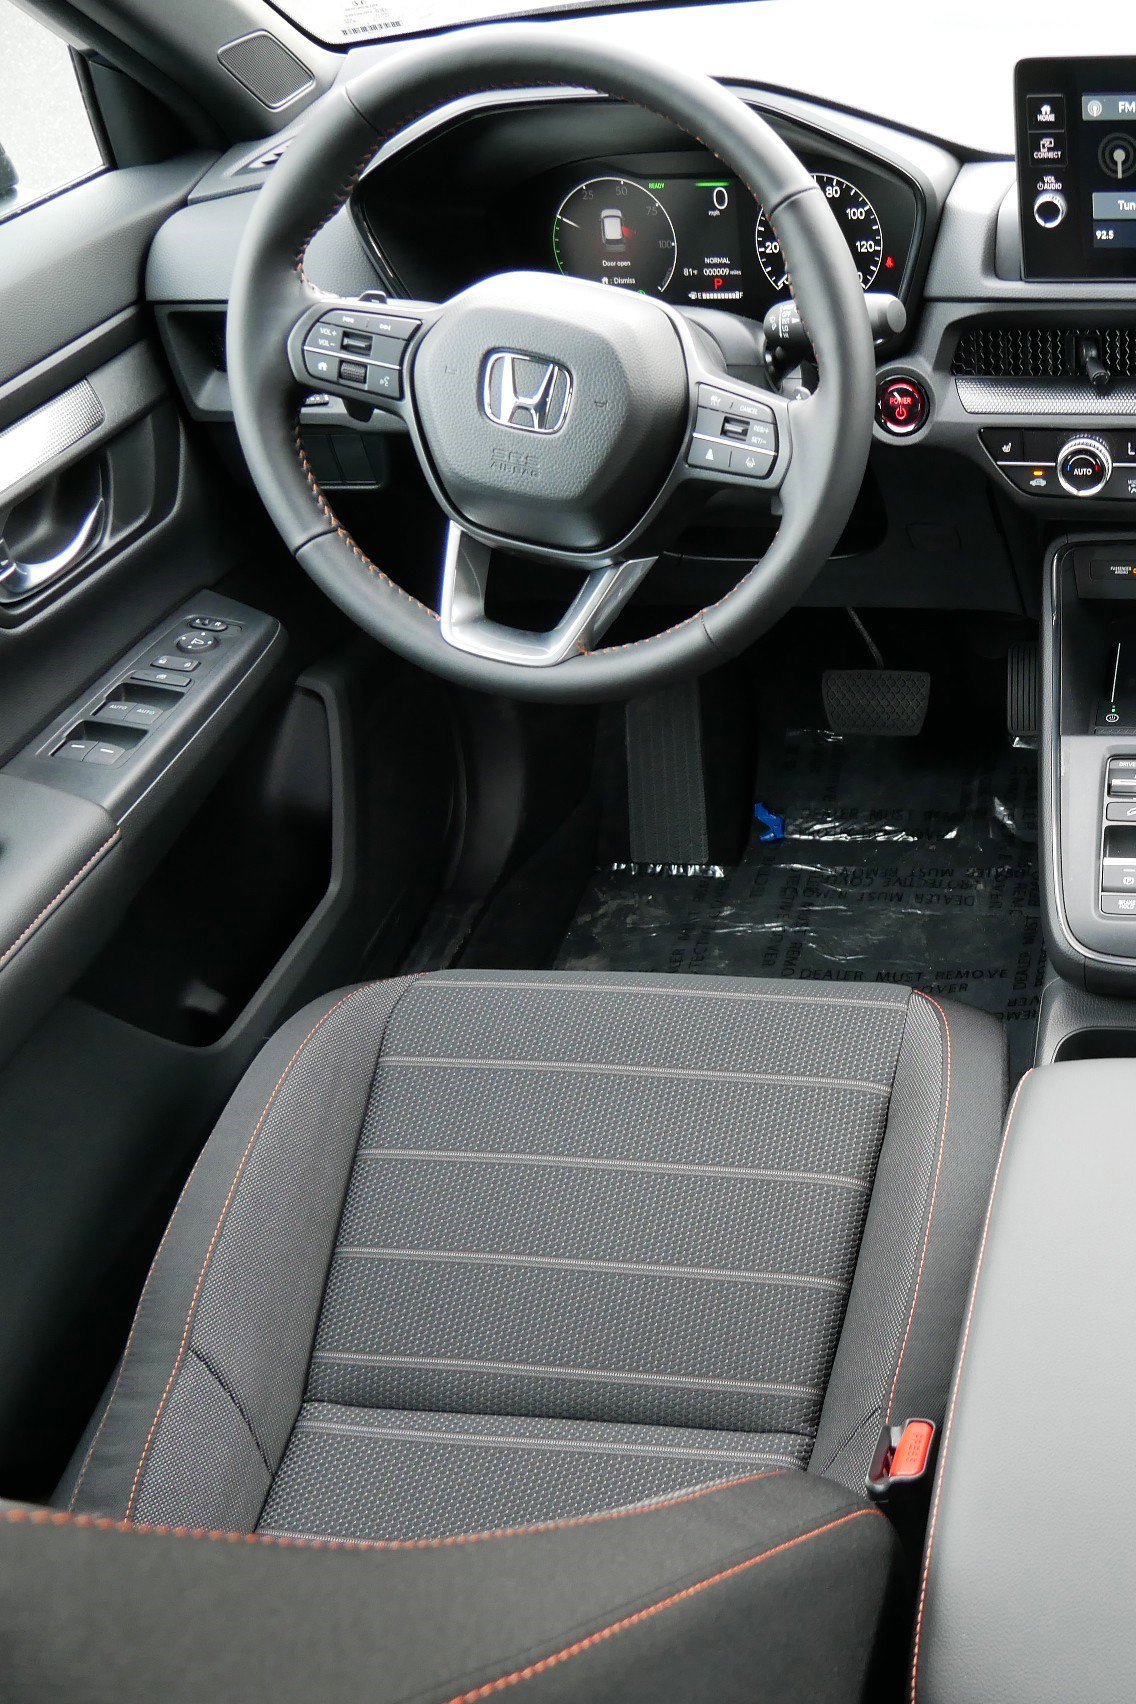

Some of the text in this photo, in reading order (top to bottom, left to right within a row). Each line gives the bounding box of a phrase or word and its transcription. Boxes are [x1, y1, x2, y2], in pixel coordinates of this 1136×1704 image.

[1119, 102, 1136, 113] FM
[1044, 182, 1062, 190] AUDIO
[583, 190, 594, 200] 25
[616, 187, 627, 196] 50
[826, 187, 840, 197] 80
[714, 187, 728, 209] 0
[646, 206, 657, 215] 75
[846, 208, 865, 219] 100
[1096, 230, 1114, 240] 92.5
[659, 240, 672, 248] 100
[766, 242, 779, 253] 20
[856, 241, 874, 252] 120
[704, 268, 729, 276] 000009
[715, 278, 724, 289] P
[890, 397, 911, 405] POWER
[740, 404, 758, 415] CANCEL
[1073, 468, 1092, 476] AUTO
[914, 892, 975, 907] DEALER
[800, 968, 1009, 983] DEALER MUST REMOVE
